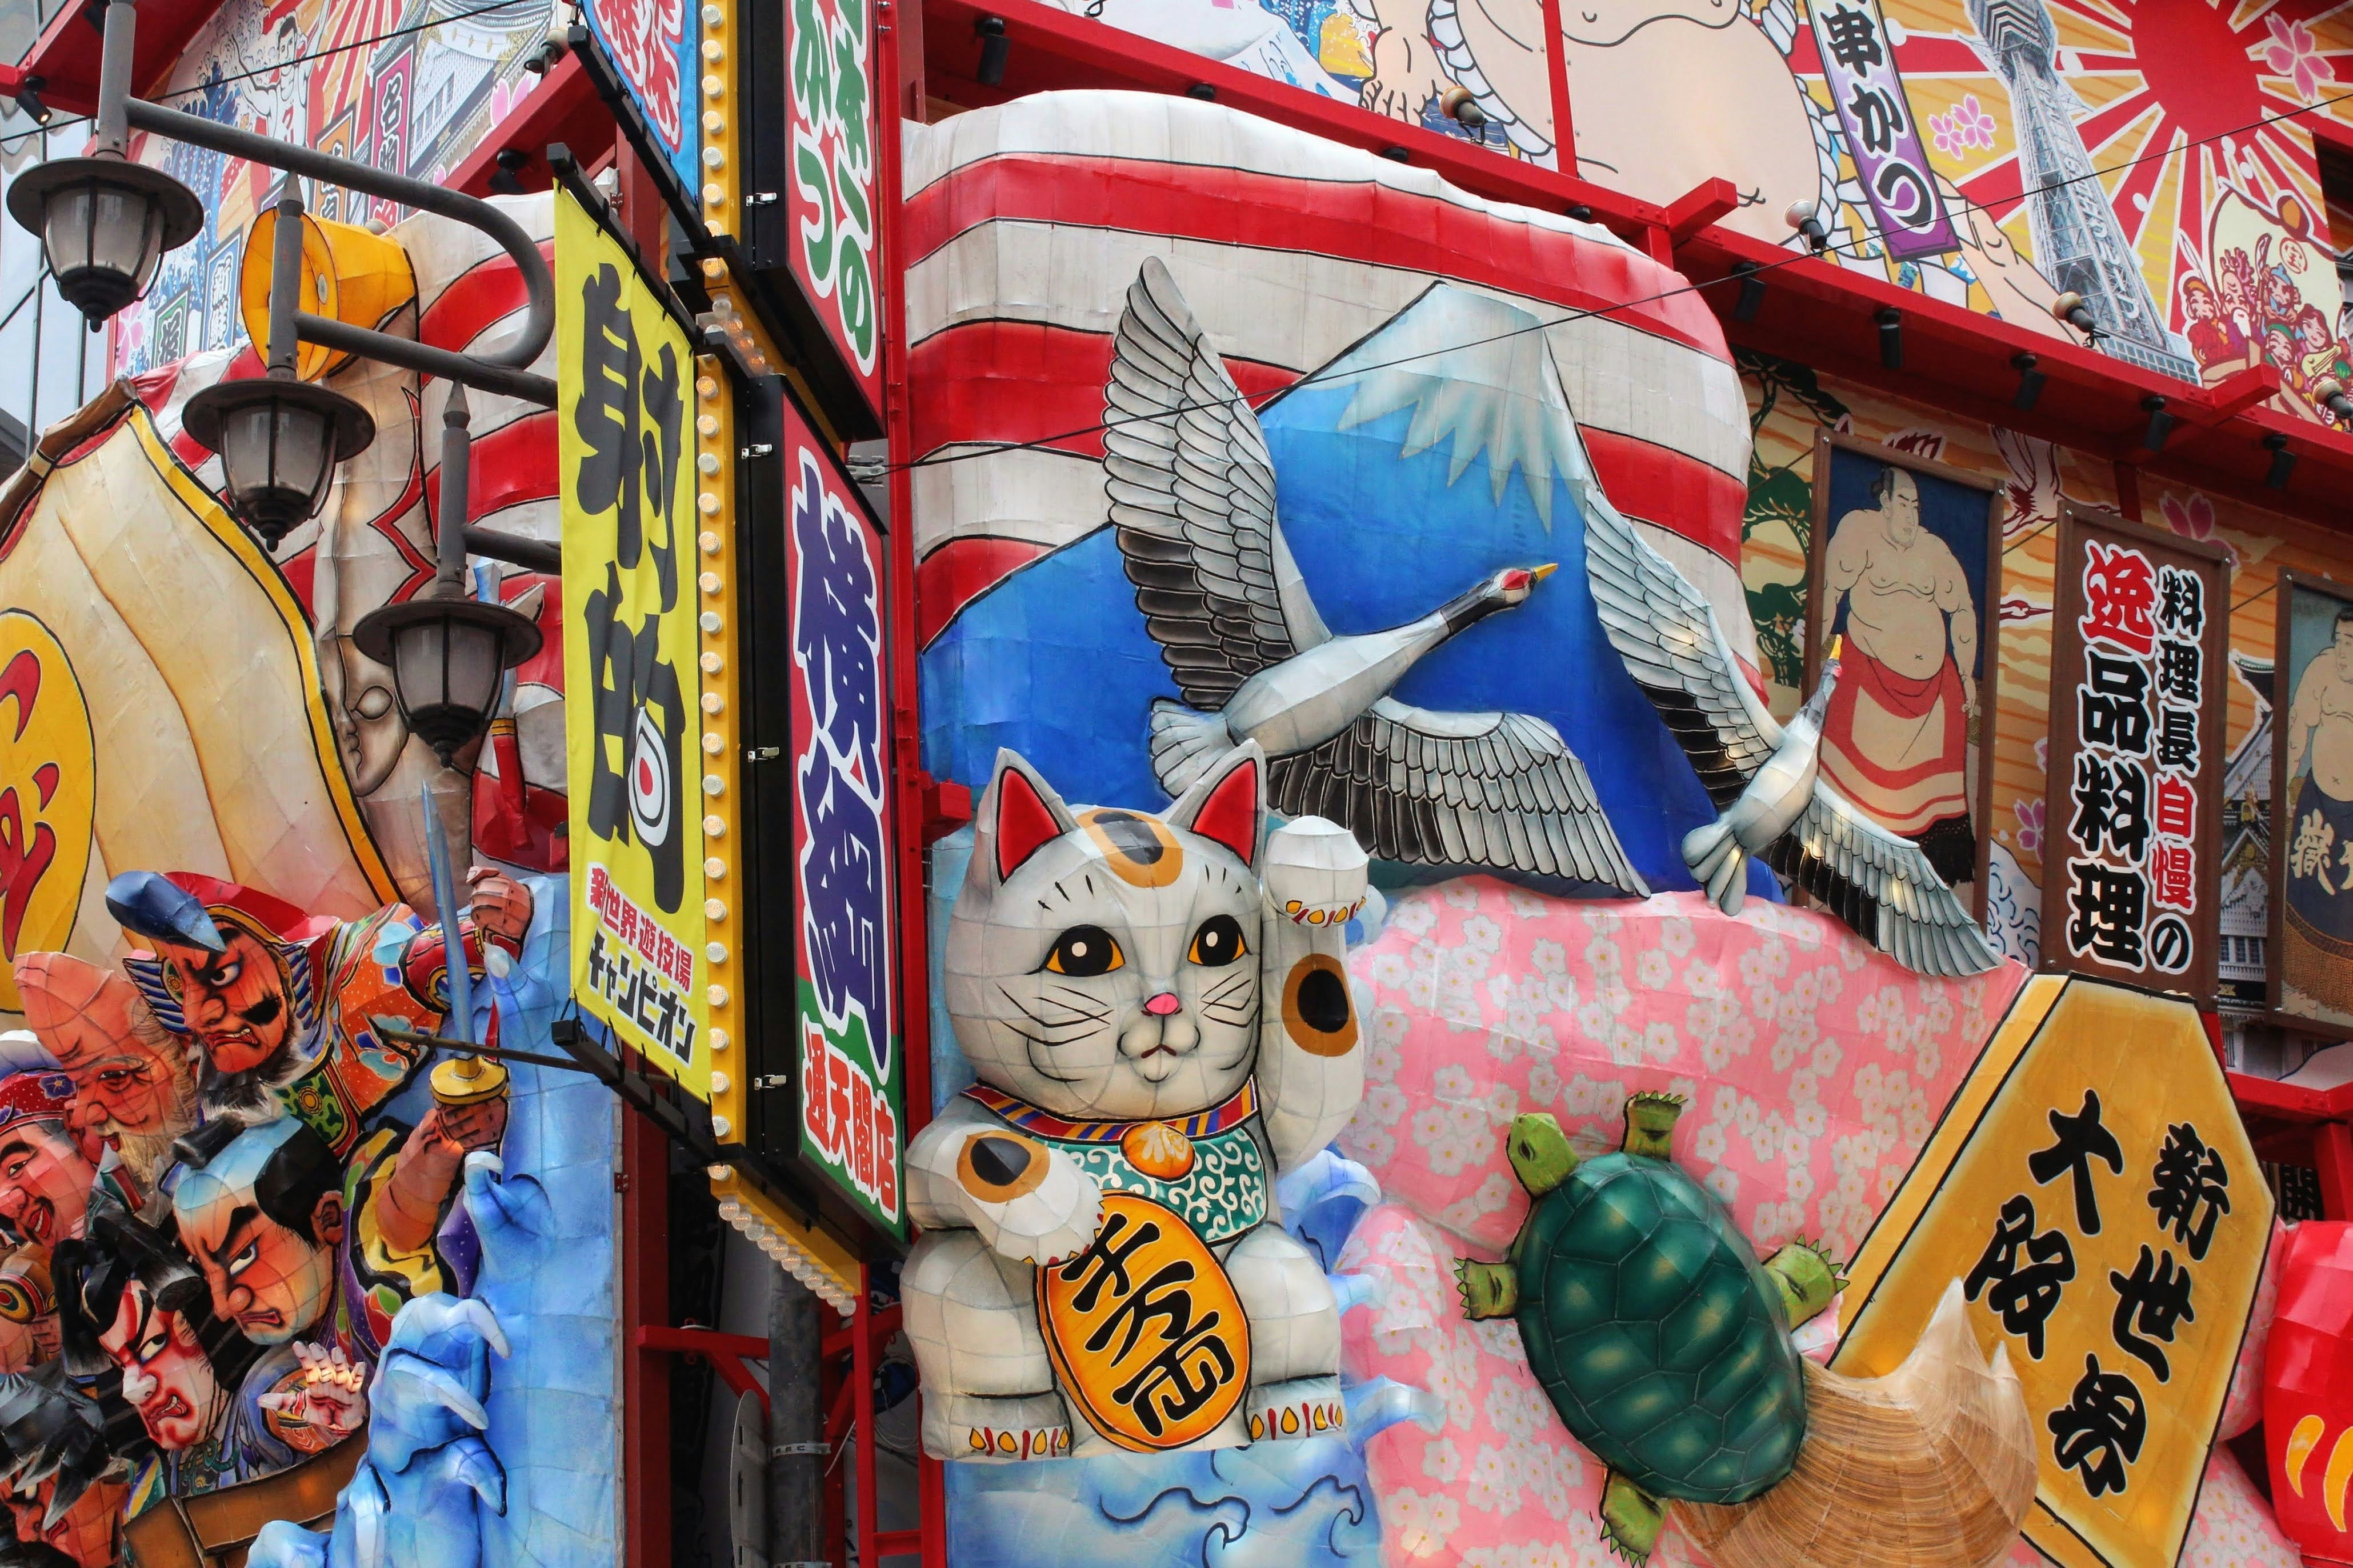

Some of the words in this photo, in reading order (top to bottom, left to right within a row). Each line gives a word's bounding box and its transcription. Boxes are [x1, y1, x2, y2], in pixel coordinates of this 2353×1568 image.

[1820, 2, 1933, 228] 串かつ
[574, 262, 687, 914] 射的
[797, 463, 886, 1070] 横綱
[2067, 542, 2157, 970] 逸品料理
[2153, 569, 2203, 970] 料理長自慢の
[589, 928, 696, 1064] チャンピオン
[590, 866, 694, 993] 新世界遊技場
[805, 1021, 897, 1214] 通天閣店
[1964, 1088, 2124, 1361] 大阪
[1060, 1211, 1236, 1437] 千万両
[2047, 1122, 2230, 1498] 新世界
